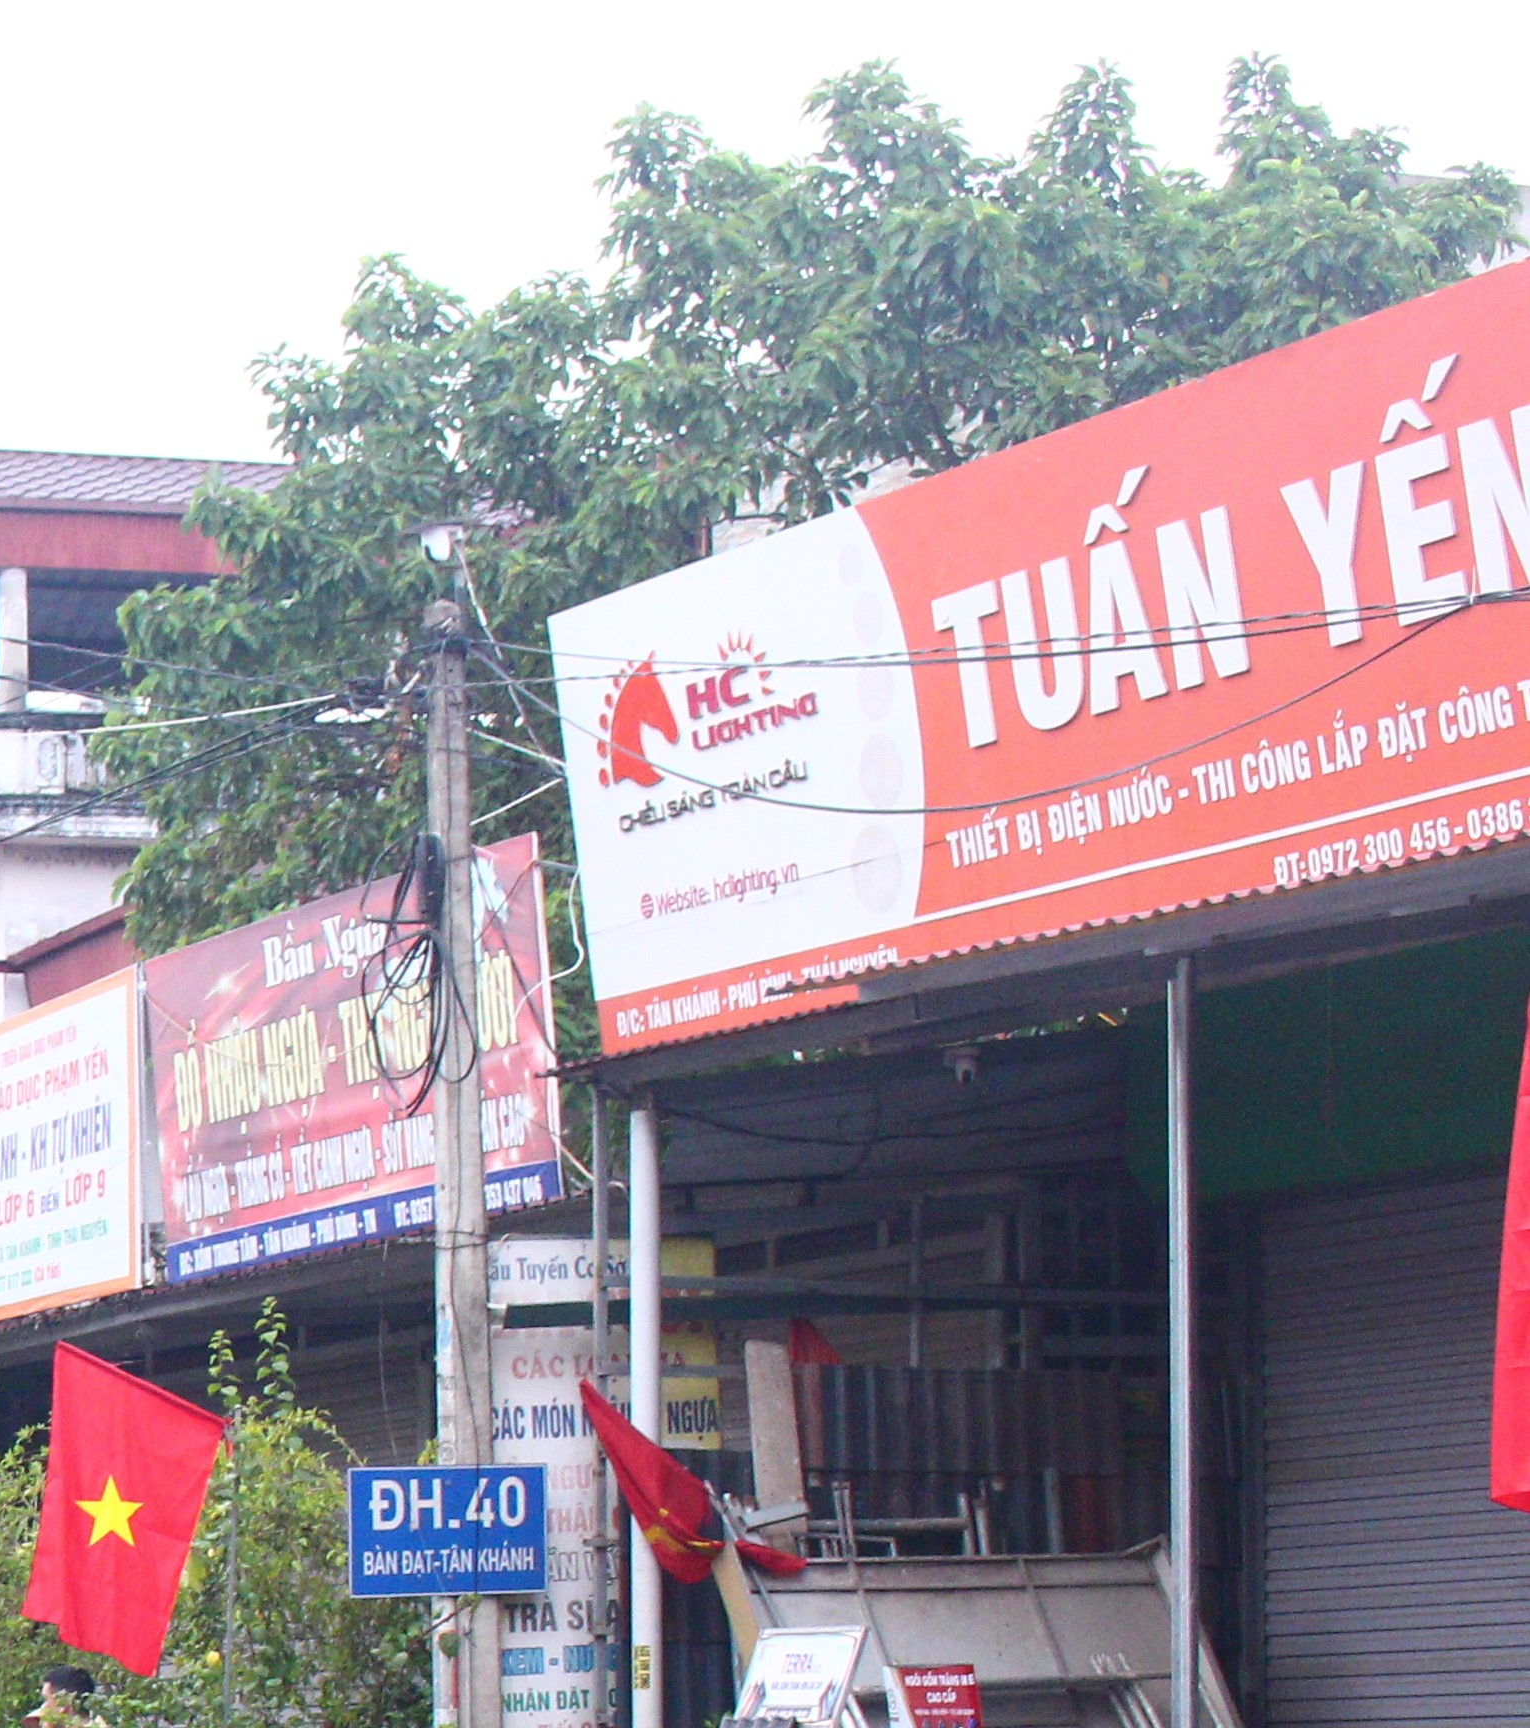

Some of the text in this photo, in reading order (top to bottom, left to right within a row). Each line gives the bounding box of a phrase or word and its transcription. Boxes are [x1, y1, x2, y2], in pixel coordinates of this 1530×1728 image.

[931, 353, 1530, 749] TUẤN YẾN
[686, 665, 752, 720] HC
[692, 691, 819, 751] LIGHTING
[945, 686, 1514, 869] THIẾT BỊ ĐIỆN NƯỚC THI CÔNG LẮP ĐẶT CÔNG
[1363, 828, 1405, 864] 300
[1409, 816, 1452, 852] 456
[1466, 799, 1525, 839] 0386
[655, 884, 711, 917] Website:
[261, 913, 388, 989] Bầu Ngựa
[615, 1012, 647, 1038] Đ/C:
[645, 998, 673, 1031] TÂN
[673, 986, 722, 1024] KHÁNH
[727, 972, 759, 1012] PHÚ
[16, 1074, 41, 1110] DỤC
[44, 1062, 81, 1097] PHẠM
[262, 1004, 325, 1119] NGỰA
[30, 1117, 48, 1172] KH
[70, 1095, 112, 1159] NHIÊN
[26, 1189, 35, 1218] 6
[64, 1169, 91, 1208] LỚP
[97, 1168, 106, 1198] 9
[511, 1350, 565, 1380] CÁC
[532, 1397, 576, 1439] MÓN
[667, 1396, 719, 1442] NGỰA
[369, 1475, 527, 1532] ĐH.40
[363, 1540, 535, 1578] BÀN ĐẠT-TÂN KHÁNH
[503, 1594, 558, 1634] TRÀ
[502, 1646, 545, 1677] KEM
[501, 1685, 591, 1716] NHẬN ĐẶT
